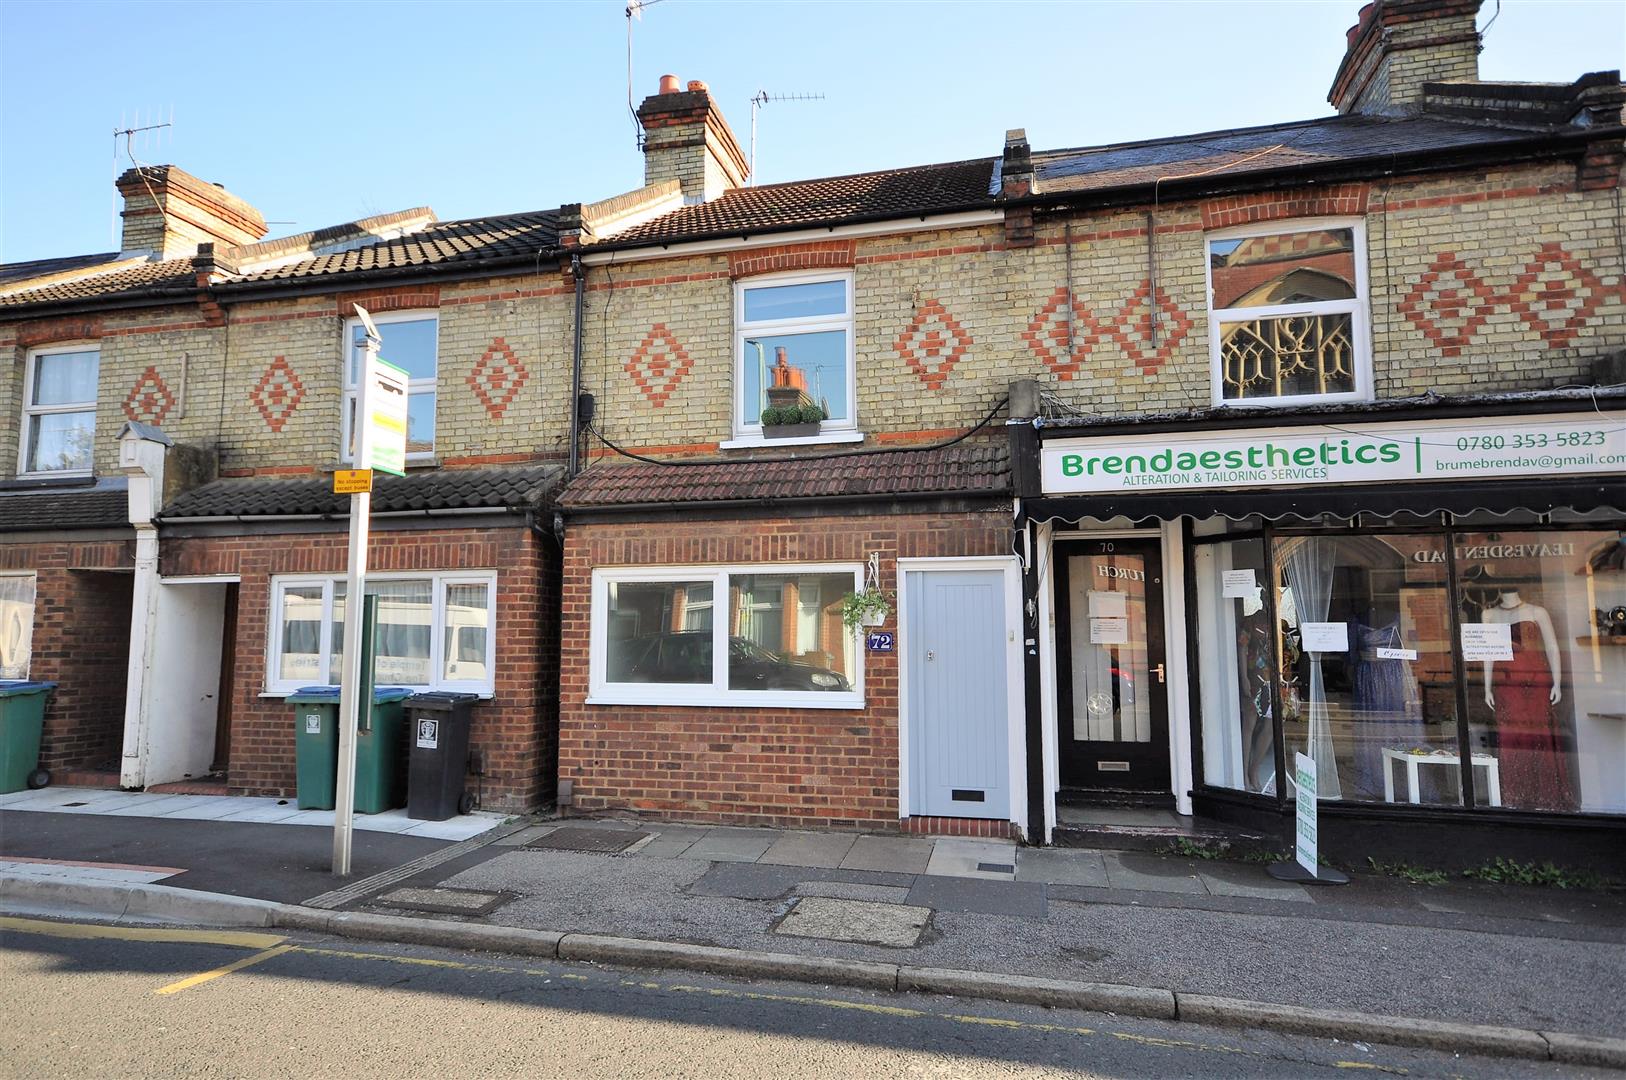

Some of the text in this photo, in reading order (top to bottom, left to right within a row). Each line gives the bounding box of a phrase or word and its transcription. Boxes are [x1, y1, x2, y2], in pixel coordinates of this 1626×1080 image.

[1457, 431, 1606, 451] 0780 353 5823
[1062, 440, 1401, 477] Brendaesthetics
[1123, 467, 1327, 486] ALTERATION & TAILORING SERVICES
[1100, 543, 1114, 552] 70
[871, 635, 891, 649] 72
